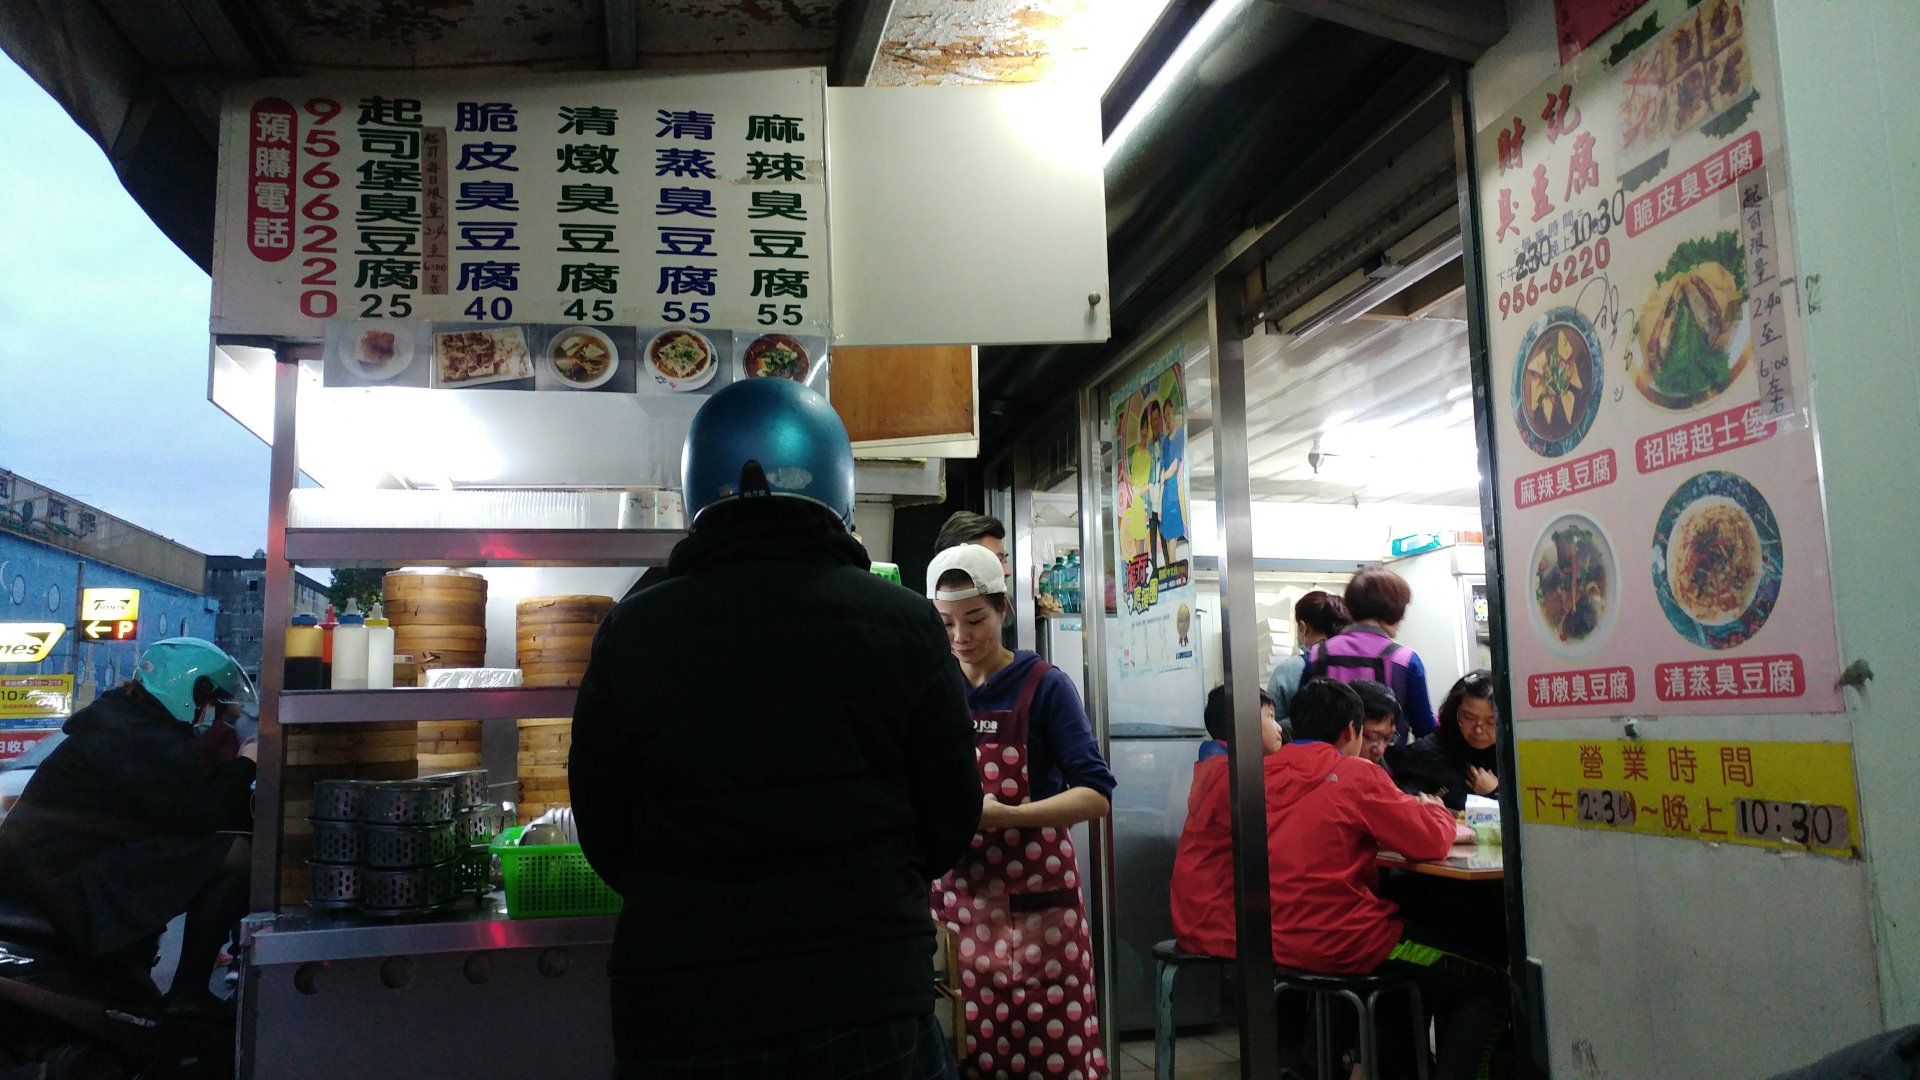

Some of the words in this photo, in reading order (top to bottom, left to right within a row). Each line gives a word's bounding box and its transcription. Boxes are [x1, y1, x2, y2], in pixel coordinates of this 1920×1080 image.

[253, 112, 292, 249] 預購電話
[355, 96, 423, 290] 起司堡臭豆腐
[454, 102, 520, 292] 脆皮臭豆腐
[556, 106, 620, 294] 清燉臭豆腐
[655, 109, 718, 297] 清蒸臭豆腐
[746, 114, 809, 298] 麻辣臭豆腐
[1633, 139, 1753, 232] 脆皮臭豆腐
[359, 294, 412, 318] 25
[1499, 237, 1610, 321] 956-6220
[464, 297, 512, 320] 40
[564, 299, 614, 322] 45
[661, 301, 711, 323] 55
[757, 304, 803, 325] 55
[1644, 407, 1768, 470] 招牌起士堡
[1520, 455, 1610, 506] 麻辣臭豆腐
[1534, 671, 1629, 705] 清燉臭豆腐
[1664, 661, 1796, 697] 清蒸臭豆腐
[1580, 745, 1754, 788] 營業時間
